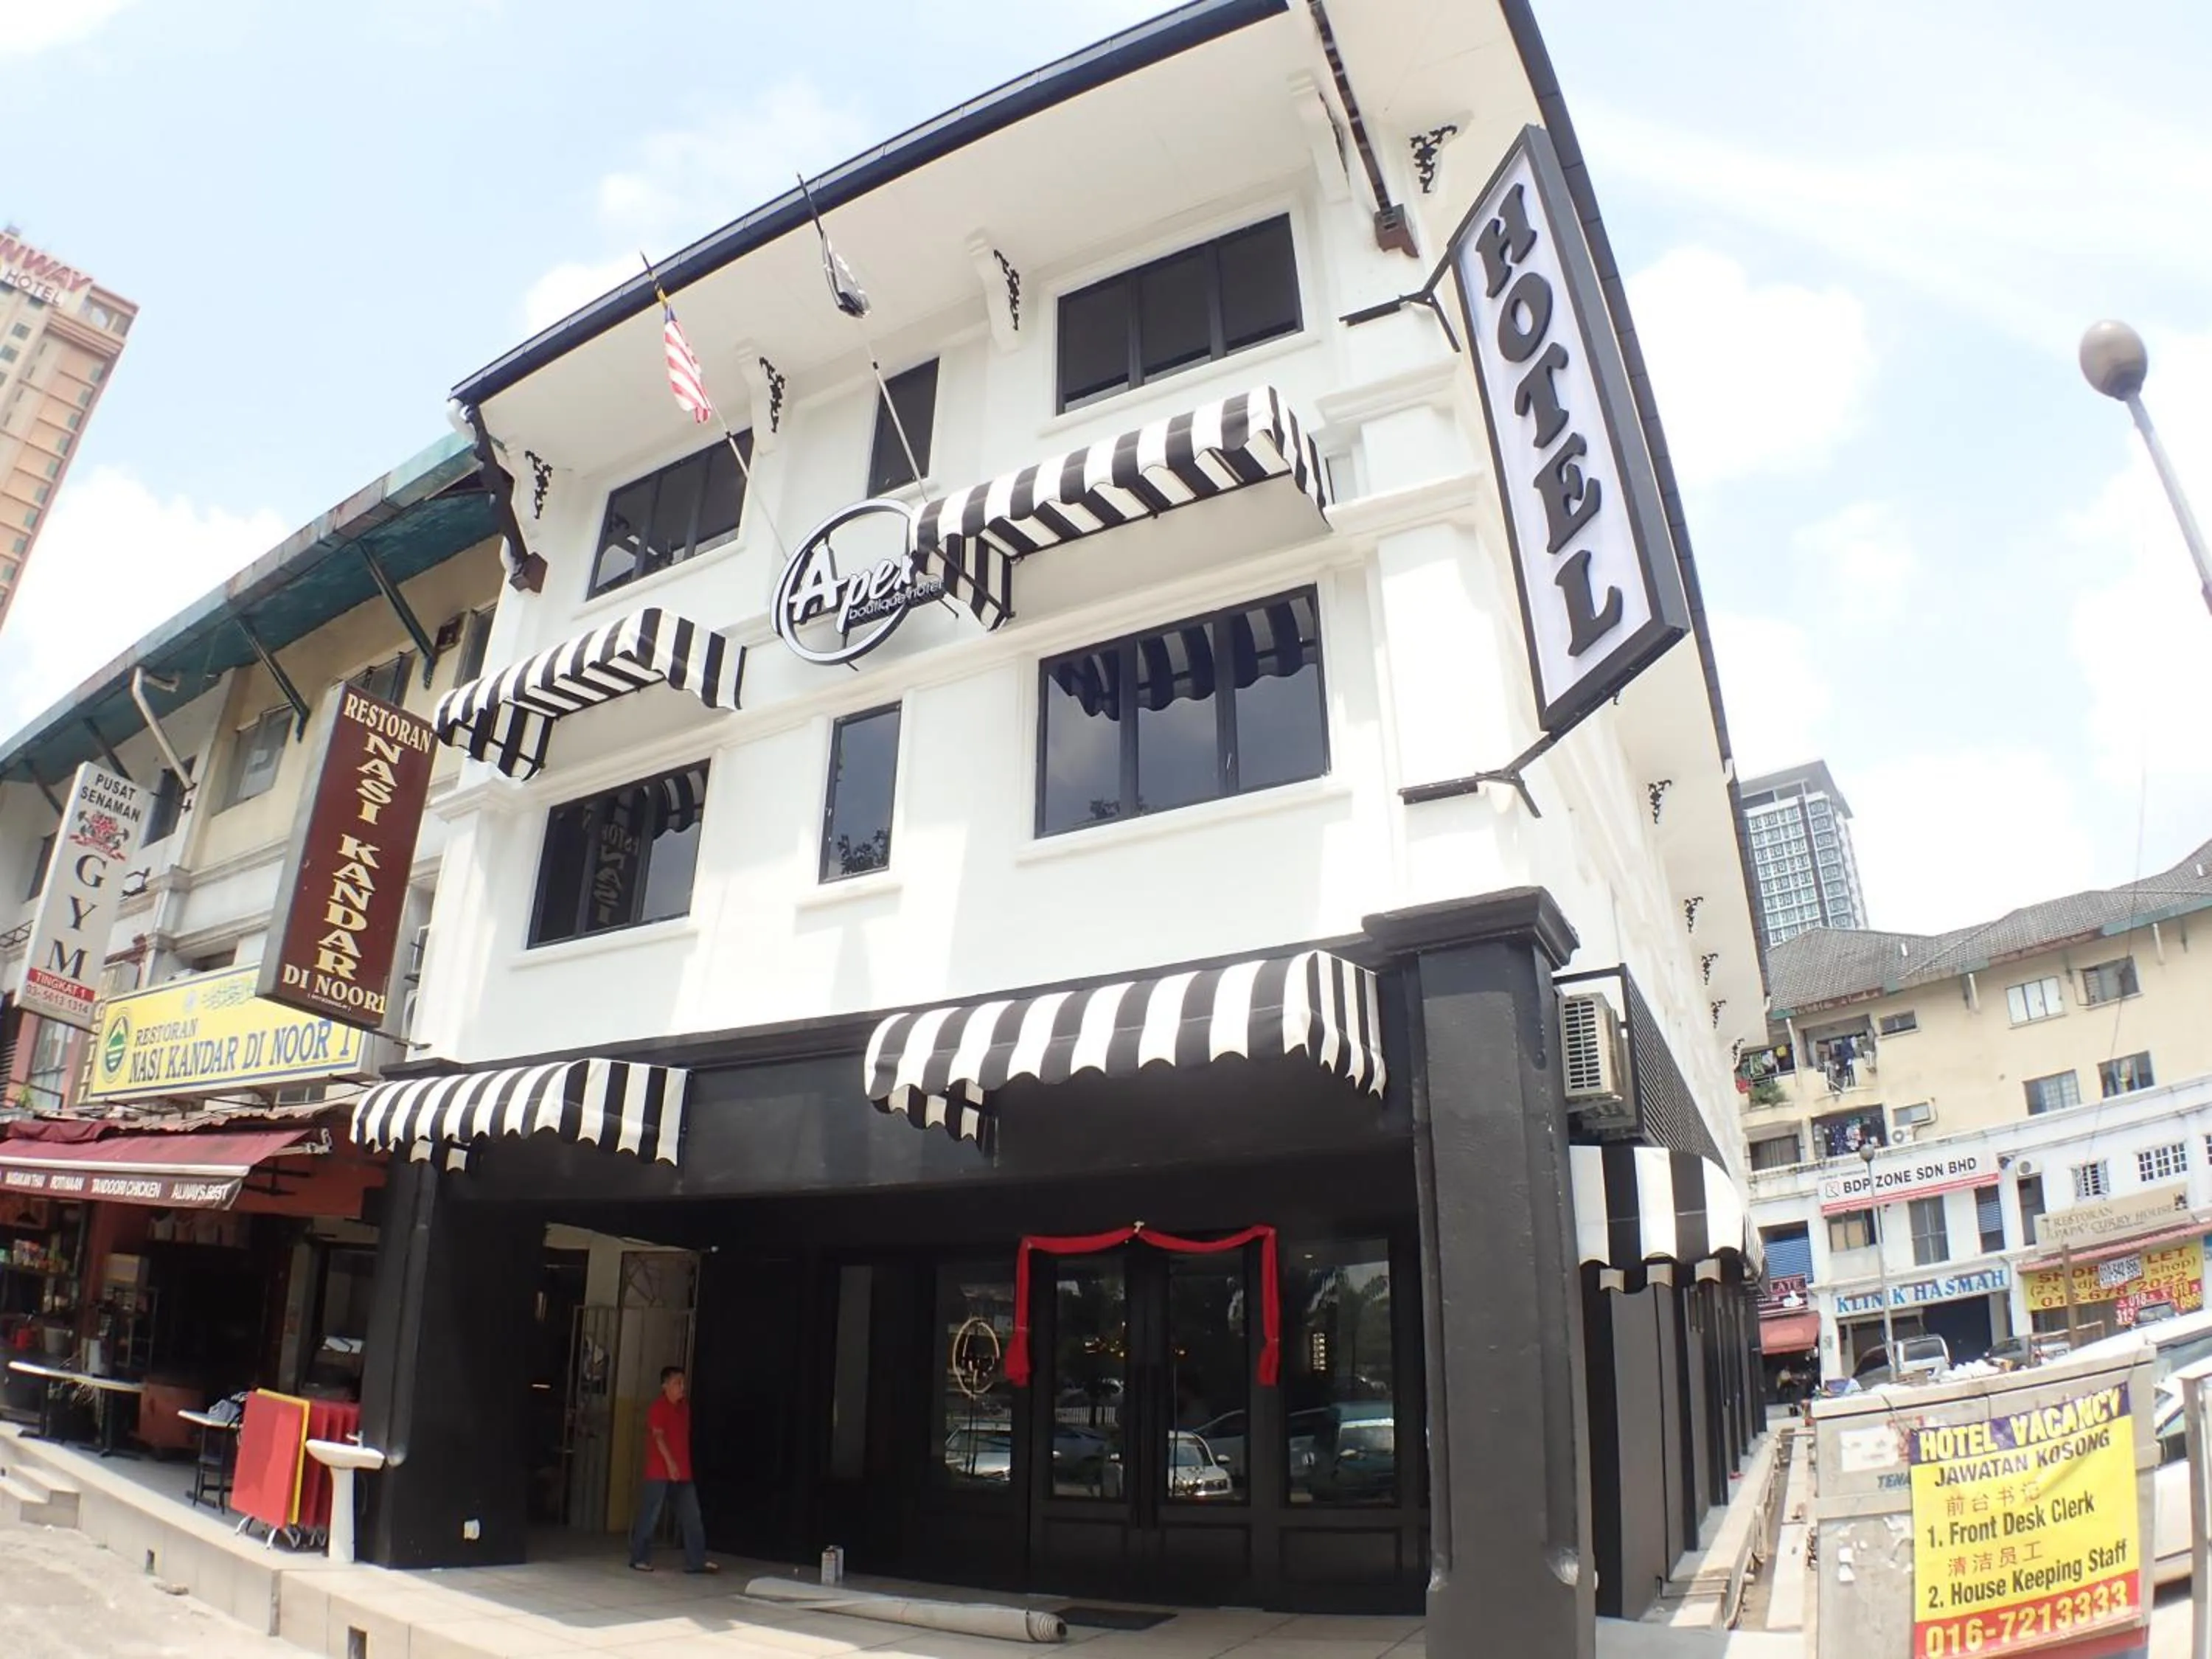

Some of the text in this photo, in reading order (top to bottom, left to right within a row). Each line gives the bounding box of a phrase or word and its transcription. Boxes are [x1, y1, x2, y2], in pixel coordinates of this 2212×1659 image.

[0, 234, 93, 292] NWAY
[4, 268, 62, 306] HOTEL
[1474, 182, 1623, 658] HOTEL
[849, 580, 944, 619] boutique hotel
[344, 693, 434, 754] RESTORAN
[94, 773, 136, 801] PUSAT
[356, 732, 404, 825] NASI
[80, 785, 141, 822] SENAMAN
[44, 854, 108, 981] GYM
[315, 834, 380, 981] KANDAR
[36, 972, 86, 998] TINGKAT 1
[282, 963, 310, 989] DI
[128, 1048, 164, 1083] NASI
[164, 1036, 240, 1079] KANDAR
[242, 1030, 266, 1069] DI
[269, 1019, 332, 1065] NOOR
[135, 1018, 198, 1047] RESTORAN
[1843, 1180, 1871, 1194] BDP
[1875, 1169, 1912, 1188] ZONE
[1916, 1163, 1944, 1180] SDN
[1949, 1157, 1977, 1174] BHD
[2053, 1207, 2114, 1227] RESTORAN
[2146, 1247, 2188, 1264] LET
[2150, 1256, 2197, 1276] shop)
[1836, 1269, 2006, 1313] KLINK HASMAH
[2136, 1271, 2188, 1290] 2022
[1919, 1422, 1998, 1462] HOTEL
[2010, 1388, 2121, 1447] VACANCY
[1934, 1428, 2110, 1487] JAWATAN KOSONG
[1927, 1490, 2095, 1548] 1. Front Desk Clerk
[1928, 1538, 2127, 1609] 2. House Keeping Staff
[1948, 1540, 2044, 1578] 清洁员工
[1925, 1579, 2129, 1658] 016-7213333
